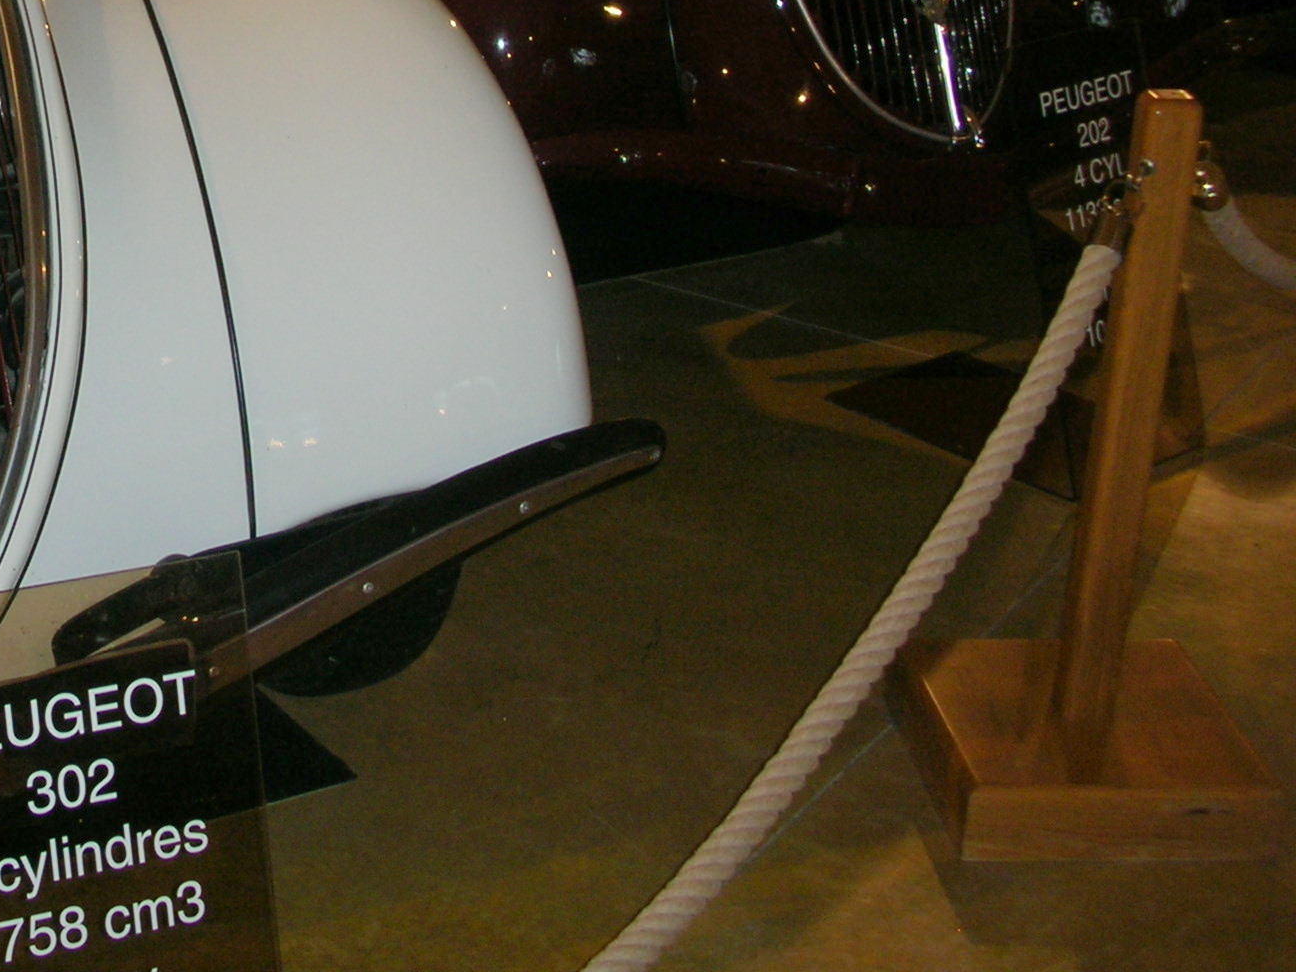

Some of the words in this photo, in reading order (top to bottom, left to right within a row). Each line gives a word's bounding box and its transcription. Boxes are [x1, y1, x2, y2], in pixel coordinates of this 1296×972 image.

[1038, 69, 1133, 118] PEUGEOT
[1077, 117, 1112, 148] 202
[1074, 164, 1086, 188] 4
[27, 758, 118, 815] 302
[104, 880, 207, 940] cm3
